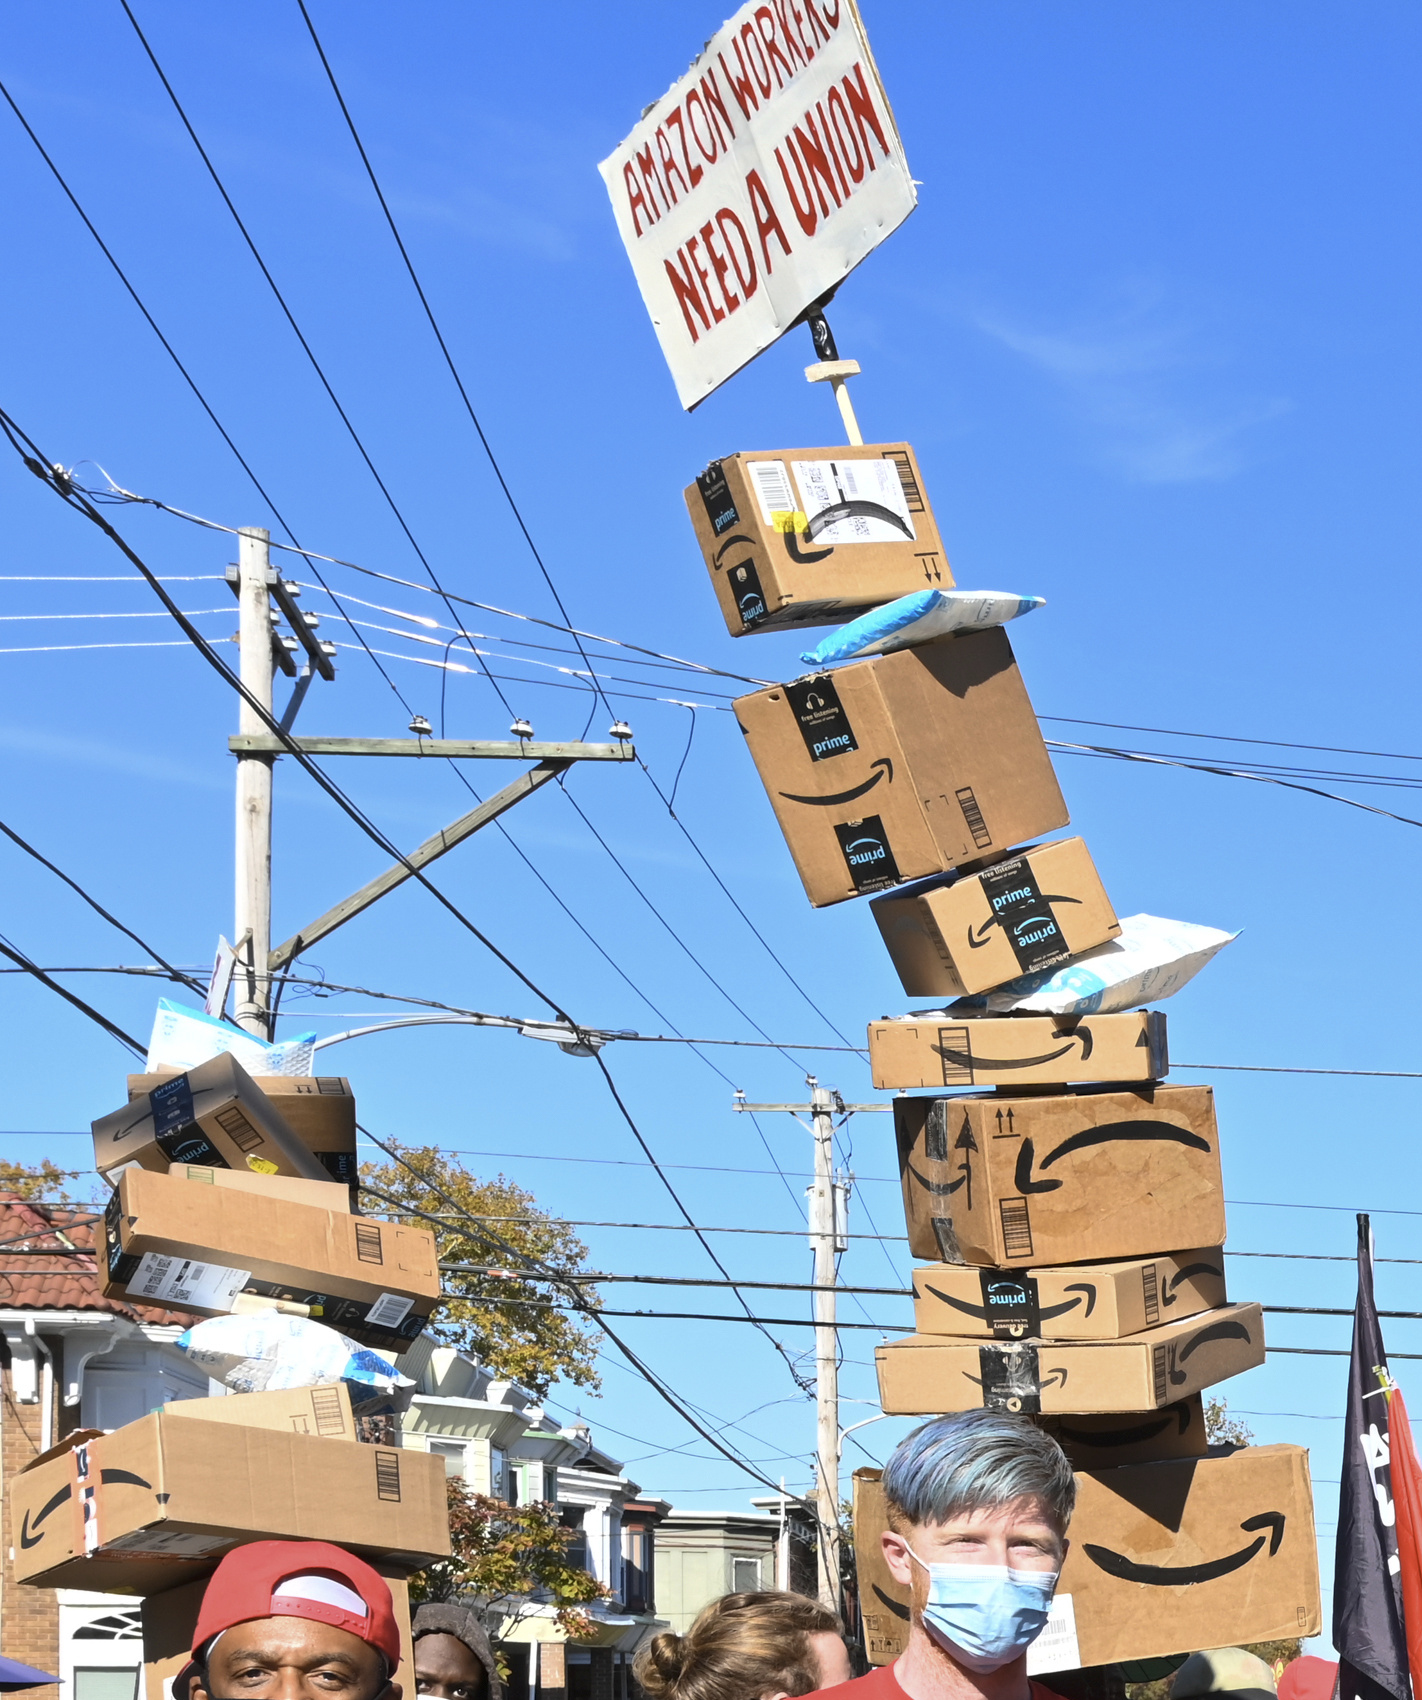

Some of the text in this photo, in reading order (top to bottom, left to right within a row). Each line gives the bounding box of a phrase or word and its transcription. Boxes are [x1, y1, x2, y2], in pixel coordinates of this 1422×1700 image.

[622, 67, 737, 239] AMAZON
[663, 62, 891, 344] NEED A UNION
[713, 506, 737, 532] prime
[742, 602, 765, 621] prime
[813, 733, 851, 756] prime
[849, 845, 886, 866] prime
[992, 886, 1032, 911] prime
[1019, 922, 1057, 948] prime
[154, 1078, 185, 1098] prime
[989, 1291, 1027, 1307] prime
